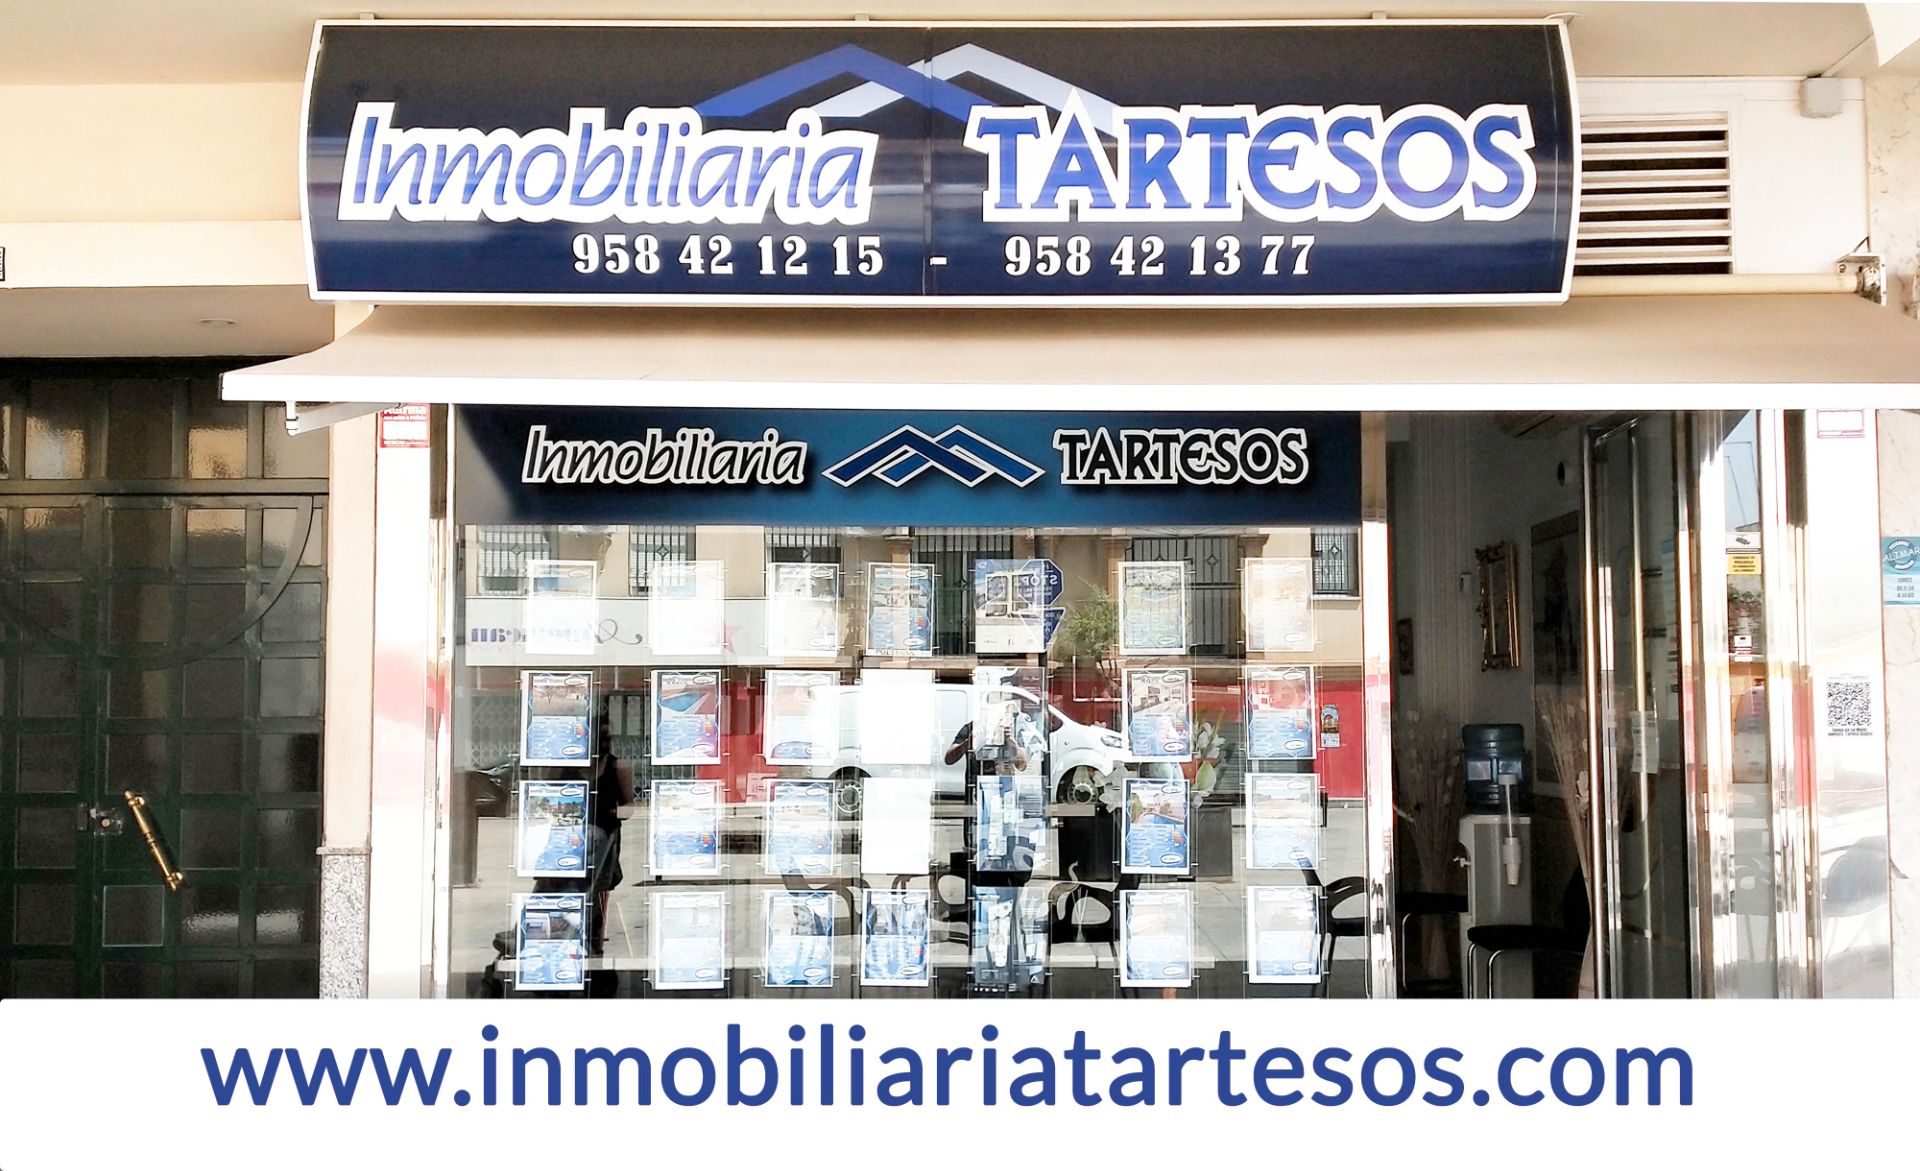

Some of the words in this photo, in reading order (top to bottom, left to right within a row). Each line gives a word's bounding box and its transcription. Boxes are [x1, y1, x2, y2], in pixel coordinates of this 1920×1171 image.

[342, 104, 876, 221] Inmobiliaria
[966, 92, 1534, 220] TARTESOS
[573, 234, 661, 275] 958
[678, 234, 734, 275] 42
[757, 234, 808, 275] 12
[832, 235, 884, 276] 15
[1005, 235, 1091, 276] 958
[1109, 235, 1165, 276] 42
[1189, 235, 1241, 276] 13
[1261, 235, 1315, 276] 77
[523, 426, 807, 484] Inmobiliaria
[1053, 427, 1309, 484] TARTESOS
